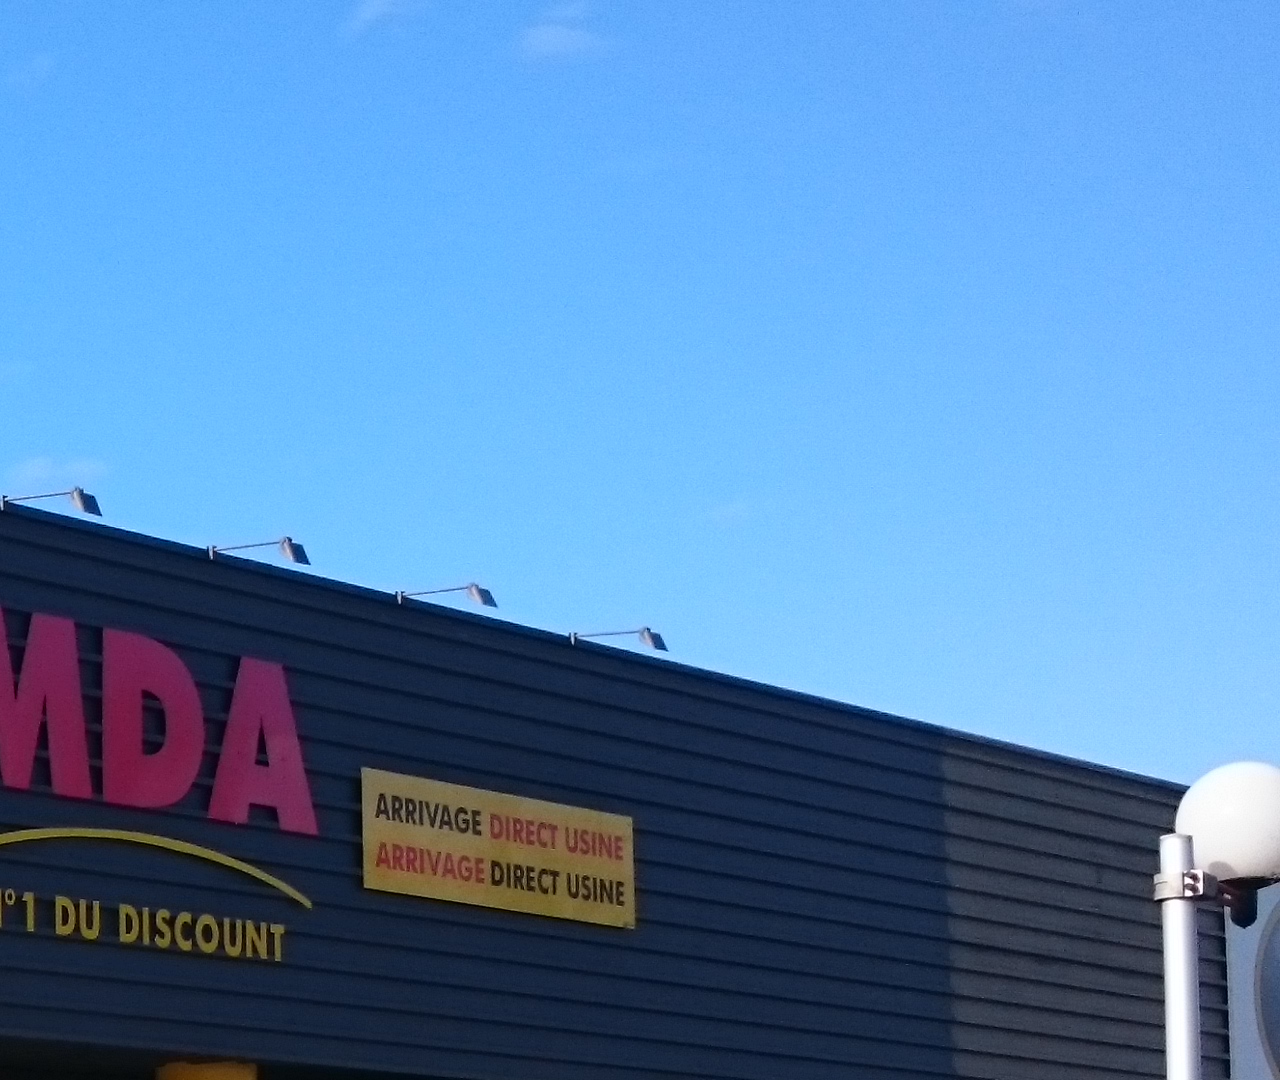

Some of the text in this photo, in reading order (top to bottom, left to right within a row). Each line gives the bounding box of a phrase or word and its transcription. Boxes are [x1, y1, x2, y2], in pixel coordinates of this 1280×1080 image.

[375, 792, 625, 862] ARRIVAGE DIRECT USINE
[375, 841, 626, 908] ARRIVAGE DIRECT USINE
[54, 895, 101, 941] DU
[118, 902, 286, 963] DISCOUNT
